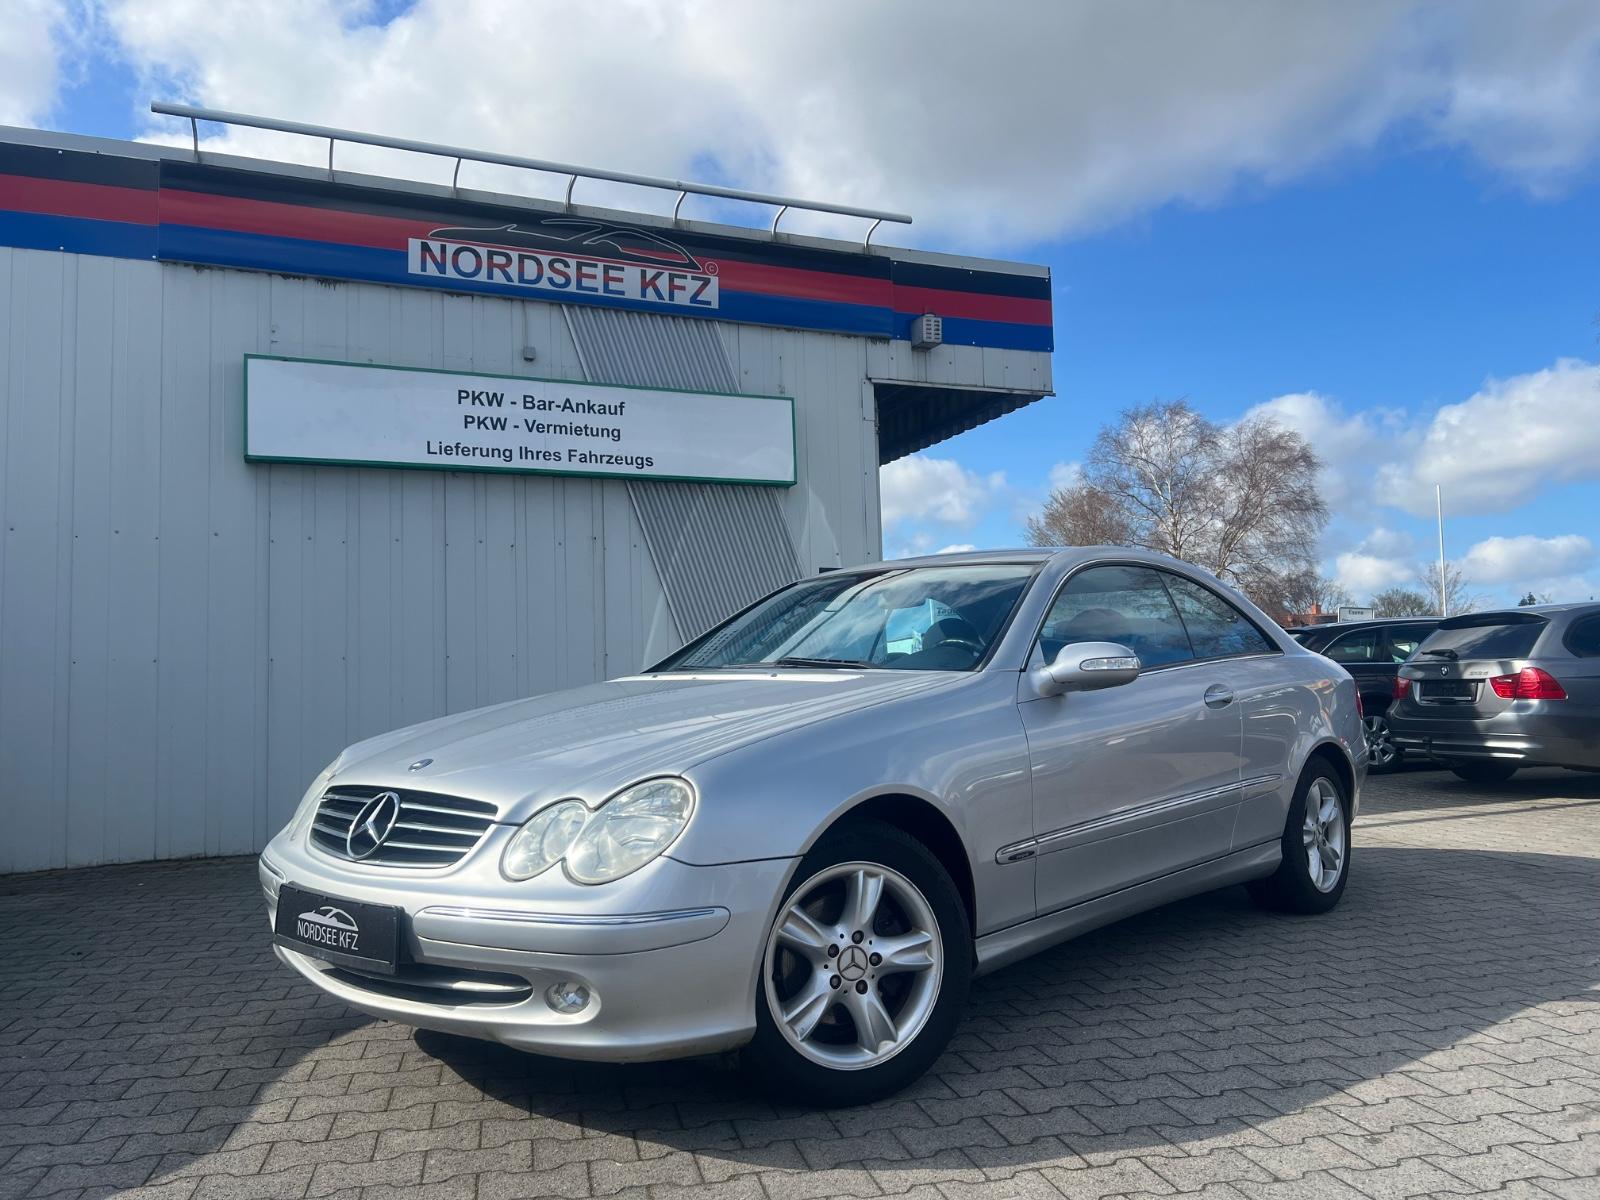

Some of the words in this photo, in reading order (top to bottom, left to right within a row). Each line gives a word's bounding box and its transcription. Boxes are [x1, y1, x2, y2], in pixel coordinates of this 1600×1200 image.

[419, 240, 626, 296] NORDSEE
[640, 268, 713, 307] KFZ
[457, 389, 505, 408] PKW
[522, 394, 626, 416] Bar-Ankauf
[463, 414, 508, 432] PKW
[524, 418, 622, 442] Vermietung
[426, 440, 513, 463] Lieferung
[519, 446, 562, 462] Ihres
[567, 449, 655, 470] Fahrzeugs
[297, 919, 338, 946] NORDSEE
[339, 930, 360, 951] KFZ
